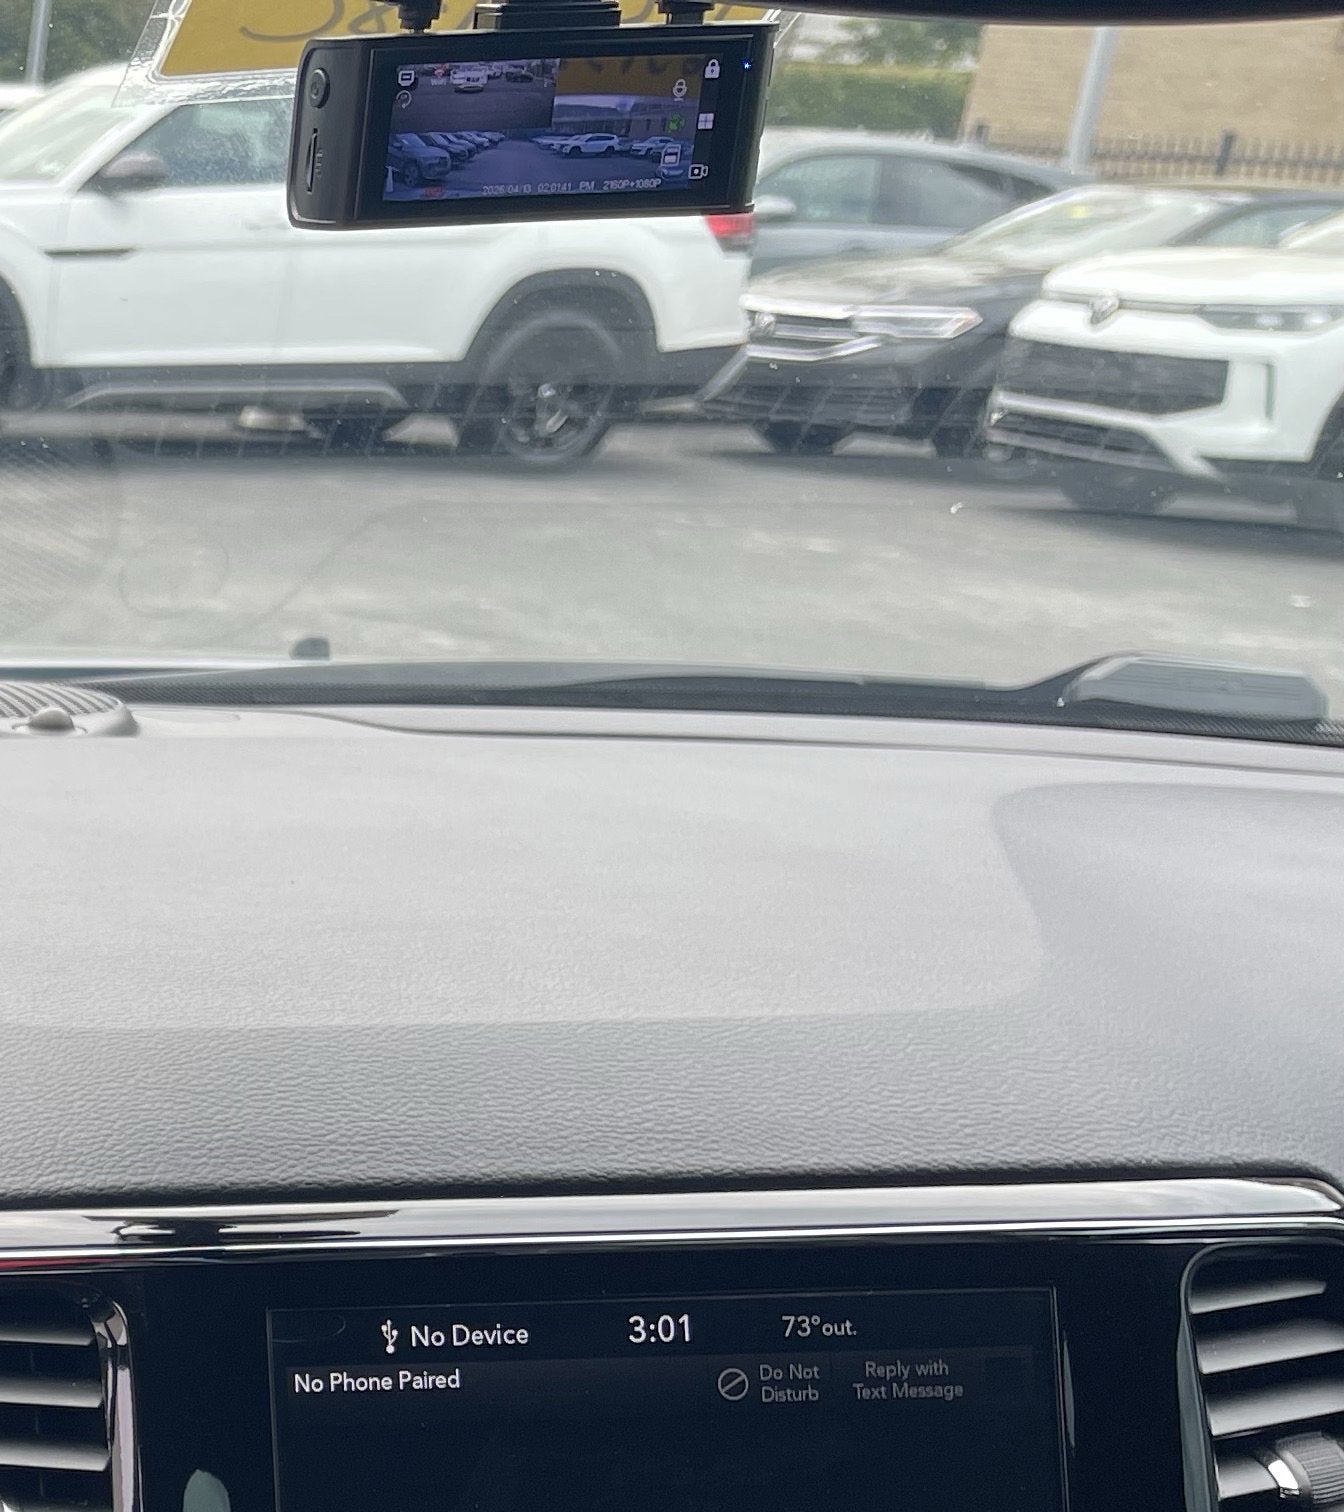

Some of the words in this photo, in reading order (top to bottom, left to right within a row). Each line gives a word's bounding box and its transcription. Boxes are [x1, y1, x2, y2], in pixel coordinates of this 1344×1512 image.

[579, 180, 595, 191] PM
[410, 1324, 446, 1347] No
[452, 1323, 529, 1347] Device
[628, 1313, 690, 1344] 3:01
[759, 1364, 783, 1381] Do
[789, 1363, 820, 1380] Not
[865, 1359, 911, 1381] Reply
[915, 1358, 949, 1377] with
[294, 1373, 324, 1393] No
[329, 1371, 393, 1392] Phone
[398, 1368, 460, 1390] Paired
[852, 1382, 887, 1400] Text
[892, 1381, 964, 1401] Message
[761, 1384, 819, 1403] Disturb
